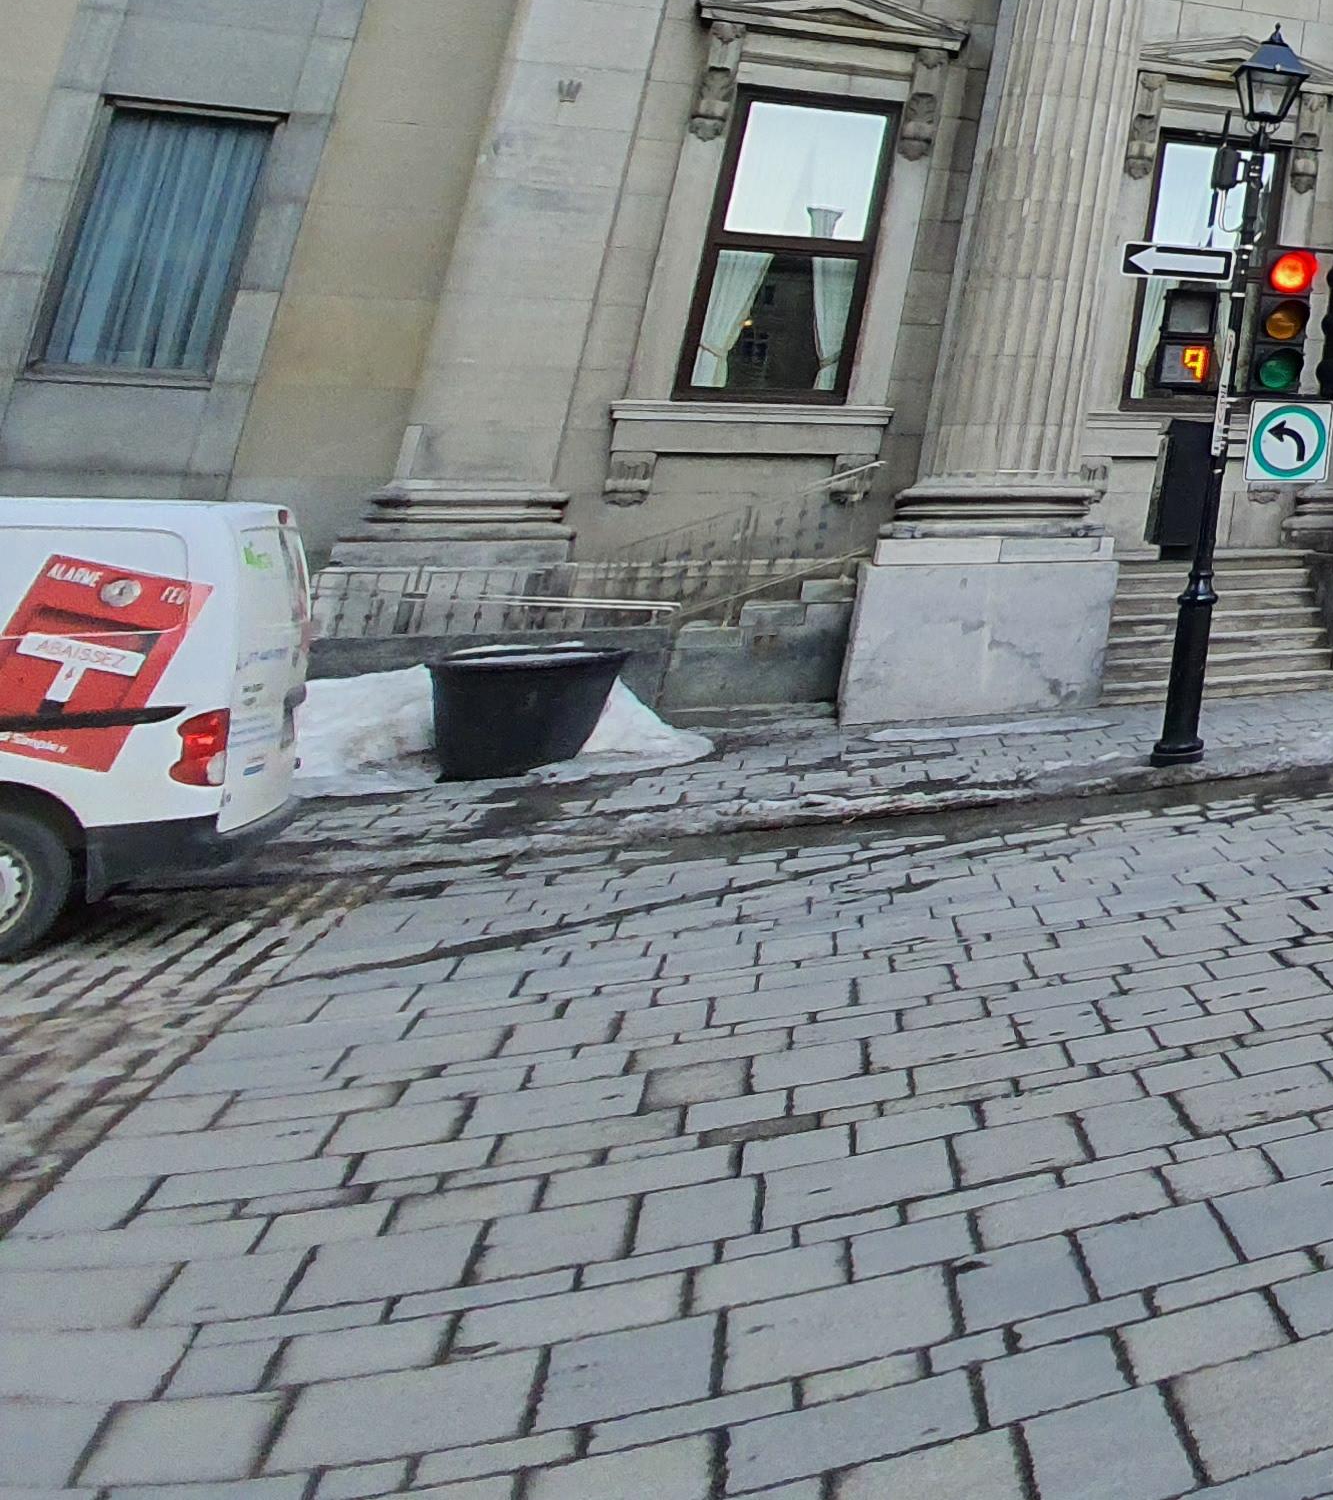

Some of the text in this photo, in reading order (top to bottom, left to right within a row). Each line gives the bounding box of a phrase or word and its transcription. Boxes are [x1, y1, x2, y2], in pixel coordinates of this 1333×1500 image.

[1183, 345, 1210, 382] 9
[47, 562, 103, 587] ALARME
[35, 640, 127, 668] ABAISSEZ
